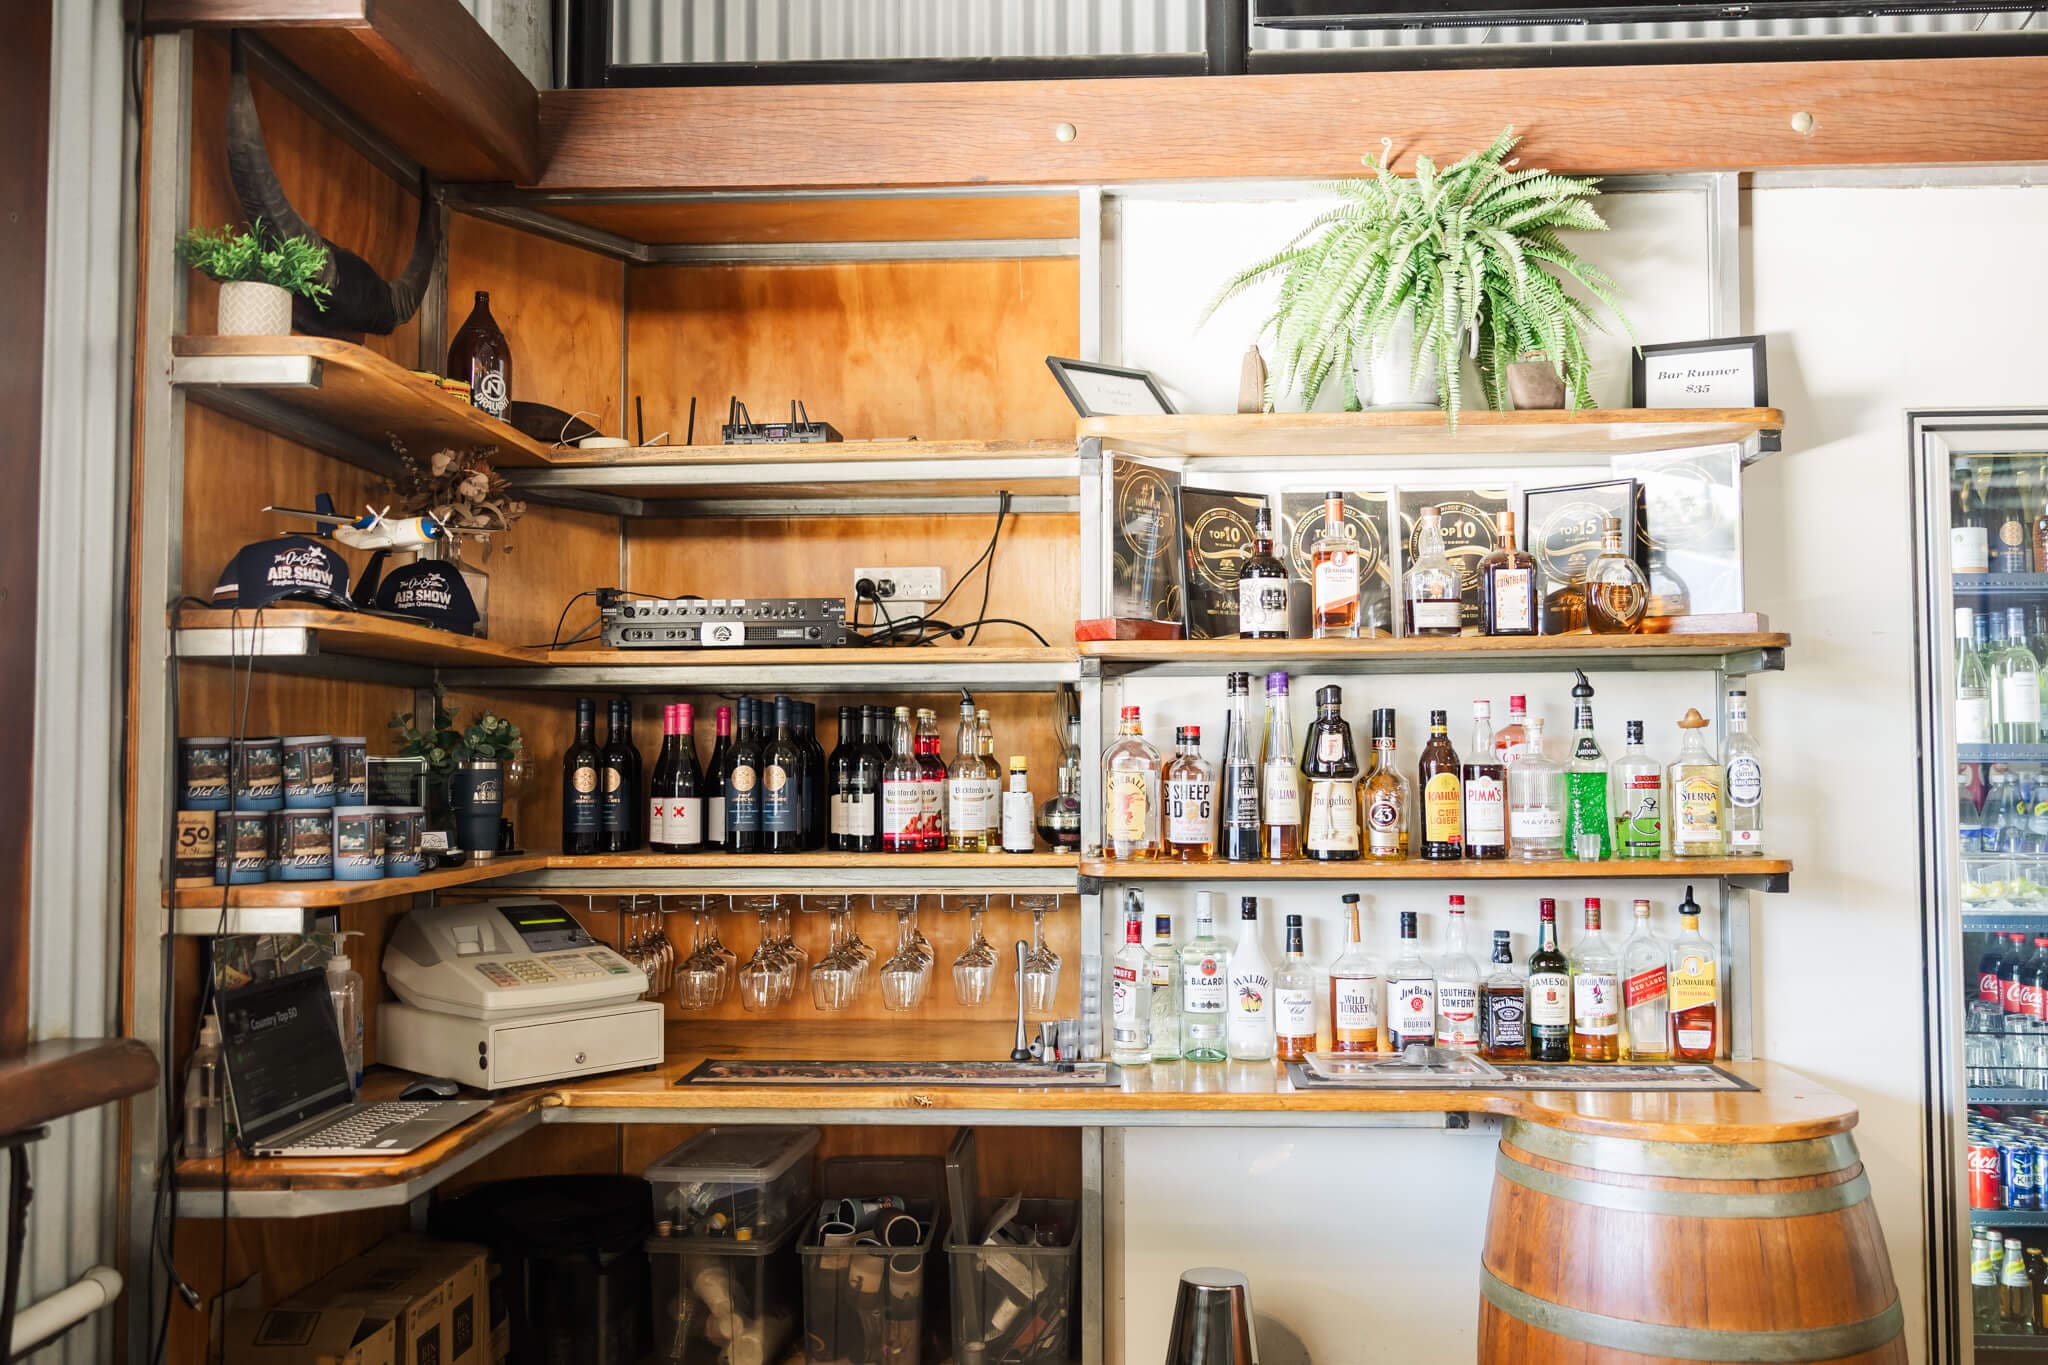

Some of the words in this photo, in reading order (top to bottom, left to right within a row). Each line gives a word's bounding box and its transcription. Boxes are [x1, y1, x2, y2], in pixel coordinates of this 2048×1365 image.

[1657, 370, 1683, 381] Bar
[1687, 367, 1740, 379] Runner
[1685, 384, 1711, 394] $35
[1440, 519, 1477, 539] OP10
[267, 566, 292, 581] AIR
[294, 566, 334, 586] SHOW
[394, 590, 414, 605] AIR
[415, 589, 452, 606] SHOW
[187, 785, 213, 798] Old
[250, 785, 275, 798] Old
[312, 782, 335, 795] Old
[1173, 784, 1210, 801] SHEEP
[1468, 786, 1503, 802] PIMM'S
[1680, 790, 1718, 802] SIERRA
[1374, 808, 1393, 822] 43
[235, 857, 264, 870] Old
[295, 853, 320, 866] Old
[1630, 983, 1645, 994] RED
[1644, 975, 1666, 988] LABEL
[1343, 994, 1366, 1005] WILD
[1399, 988, 1414, 1001] JIM
[1439, 988, 1476, 998] SOUTHERN
[1339, 1002, 1369, 1014] TURKEY
[1442, 998, 1475, 1008] COMFORT
[1403, 1020, 1432, 1029] BOURBON
